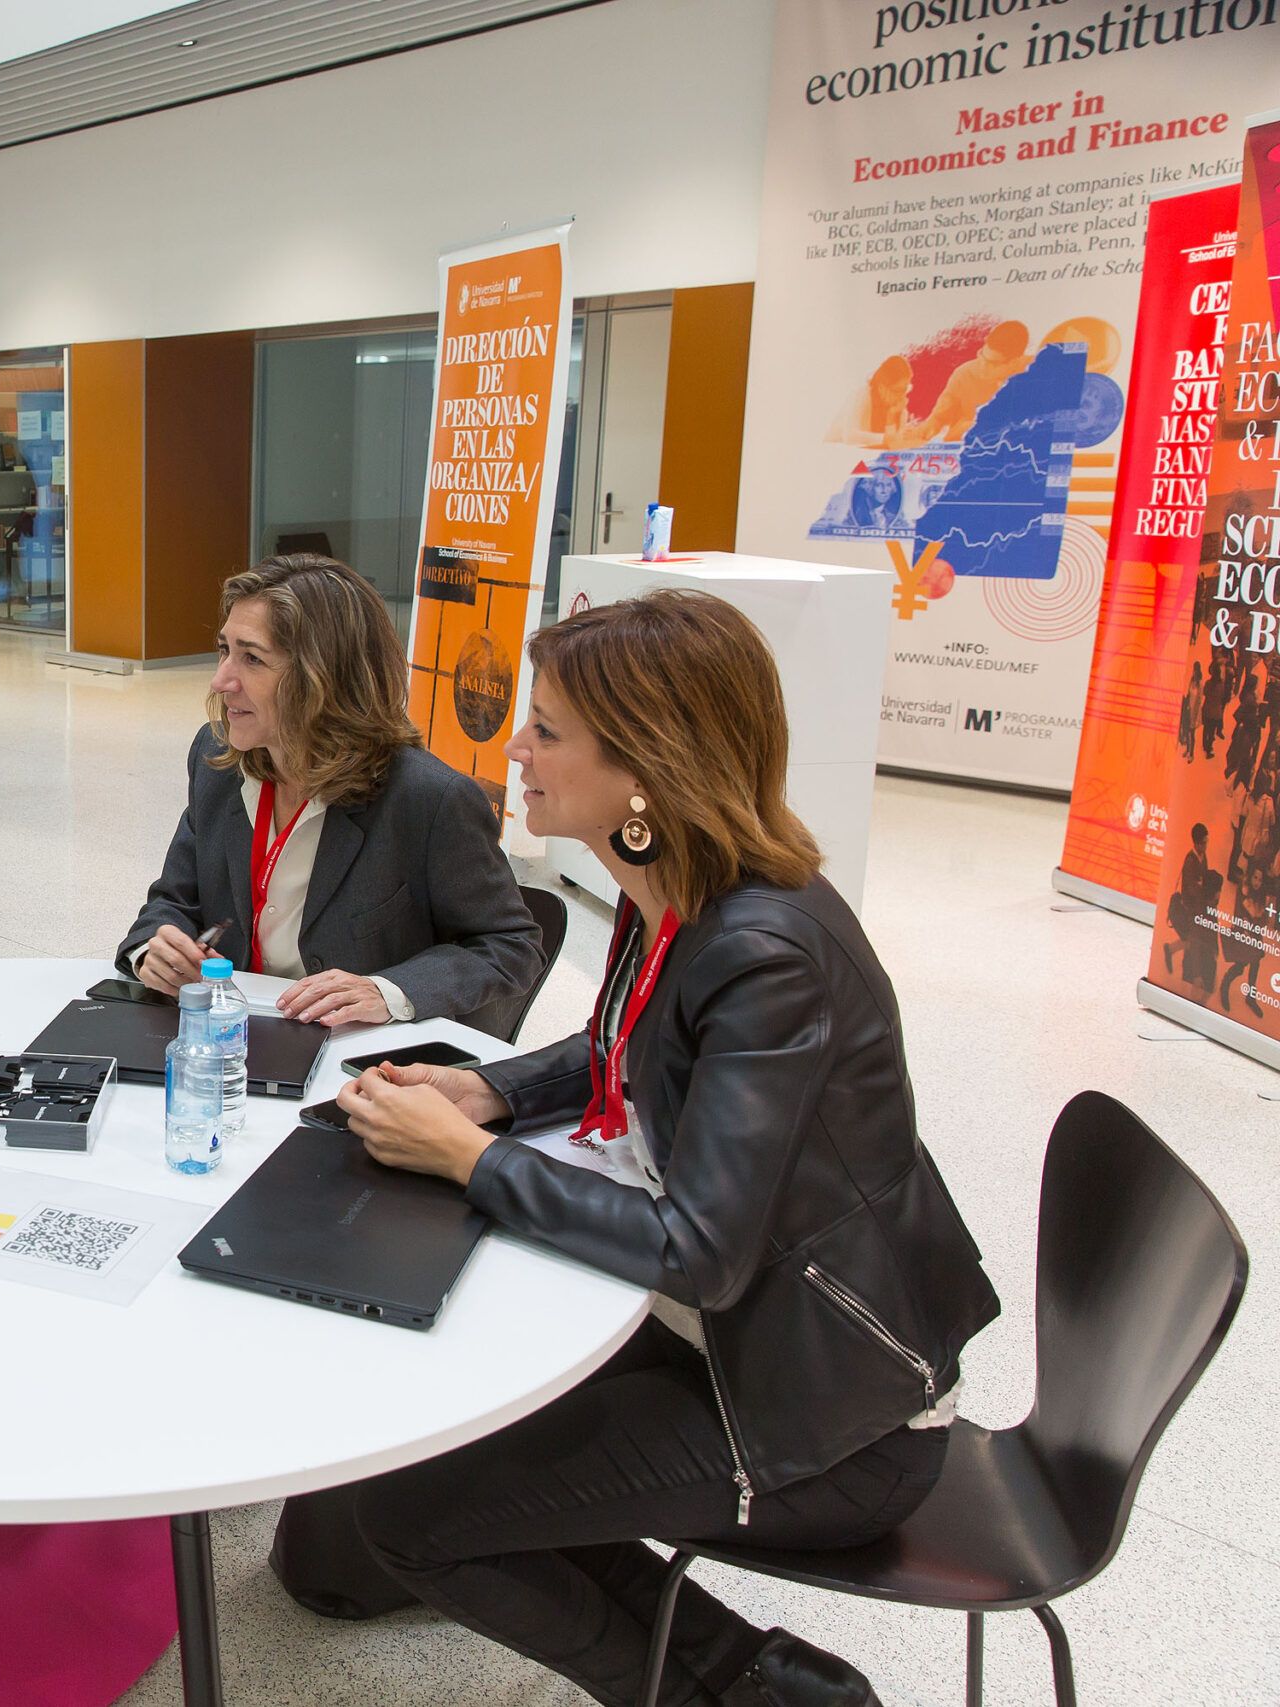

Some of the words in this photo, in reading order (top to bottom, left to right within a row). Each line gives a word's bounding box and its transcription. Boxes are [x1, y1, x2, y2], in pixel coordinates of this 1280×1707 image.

[873, 0, 1070, 48] positio
[806, 33, 1008, 105] economic
[955, 102, 1062, 135] Master
[1072, 90, 1104, 118] in
[853, 142, 1006, 183] Economics
[1017, 126, 1076, 160] and
[1087, 112, 1229, 151] Finance
[842, 202, 889, 221] alumni
[894, 200, 926, 215] have
[930, 196, 964, 210] been
[969, 187, 1032, 205] working
[1036, 184, 1051, 198] at
[1056, 172, 1144, 195] companies
[1150, 167, 1182, 184] like
[828, 224, 863, 239] BCG,
[866, 218, 929, 236] Goldman
[933, 212, 980, 228] Sachs,
[985, 207, 1043, 223] Morgan
[1118, 193, 1134, 208] at
[806, 246, 828, 260] like
[865, 238, 898, 254] ECB,
[902, 233, 950, 250] OECD,
[1008, 222, 1037, 239] and
[1042, 221, 1079, 236] were
[1084, 211, 1137, 234] placed
[850, 256, 899, 274] schools
[903, 253, 930, 269] like
[934, 250, 996, 266] Harvard,
[1001, 240, 1082, 260] Columbia,
[1188, 248, 1217, 263] School
[1217, 247, 1227, 258] of
[471, 280, 504, 297] Universidad
[876, 278, 927, 297] Ignacio
[931, 275, 987, 290] Ferrero
[1005, 268, 1046, 284] Dean
[1051, 263, 1071, 279] of
[1072, 262, 1098, 278] the
[444, 316, 552, 366] DIRECCIÓN
[1235, 320, 1280, 363] FA
[475, 363, 505, 394] DE
[440, 393, 539, 428] PERSONAS
[451, 429, 478, 459] EN
[479, 428, 516, 459] LAS
[445, 492, 510, 525] CIONES
[1134, 508, 1206, 538] REGU
[438, 548, 454, 558] School
[1210, 607, 1238, 649] &
[1245, 610, 1280, 656] B
[894, 652, 1039, 675] WWW.UNAV.EDU/MEF
[458, 674, 505, 700] ANALISTA
[880, 709, 894, 721] de
[896, 710, 946, 728] Navarra
[881, 695, 952, 715] Universidad
